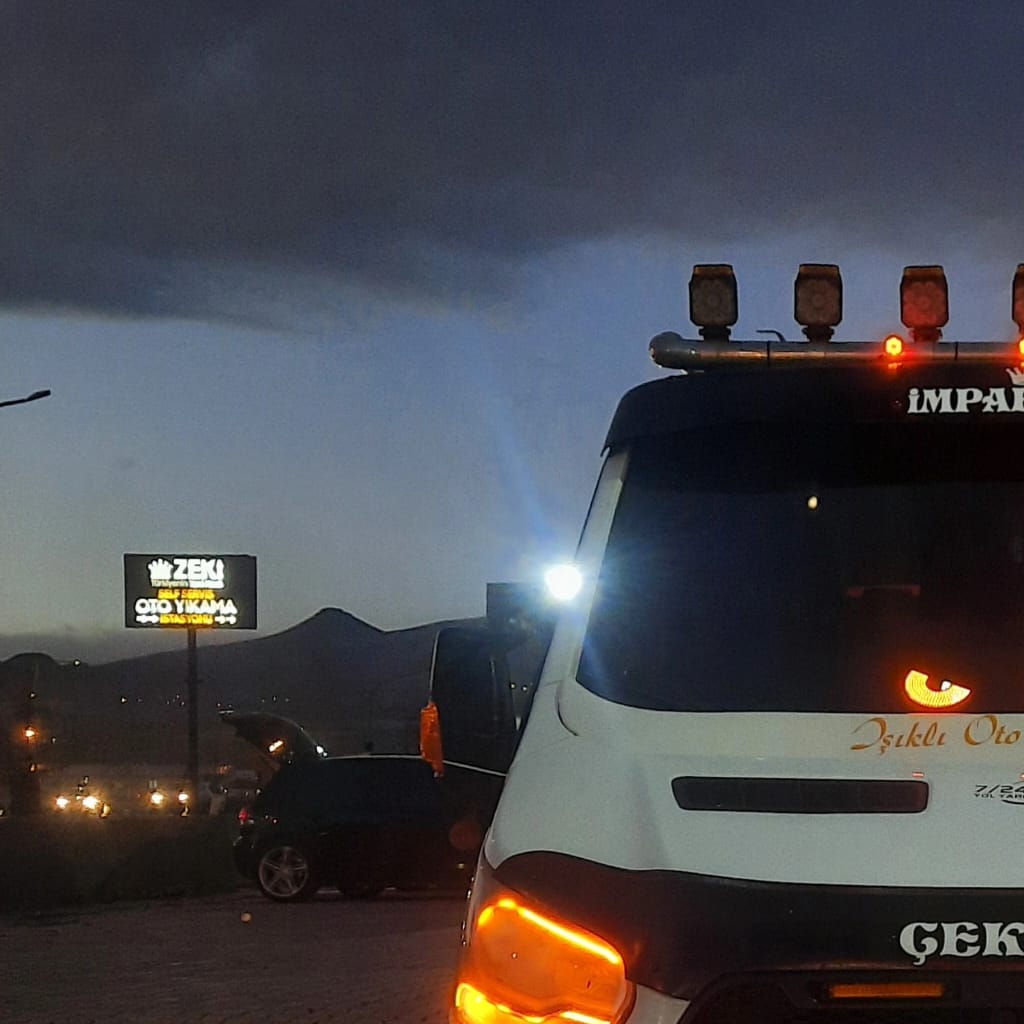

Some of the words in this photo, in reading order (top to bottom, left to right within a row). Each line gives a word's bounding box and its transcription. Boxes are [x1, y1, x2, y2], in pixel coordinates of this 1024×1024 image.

[135, 599, 172, 614] OTO
[174, 599, 238, 614] YIKAMA
[964, 714, 1022, 746] Oto
